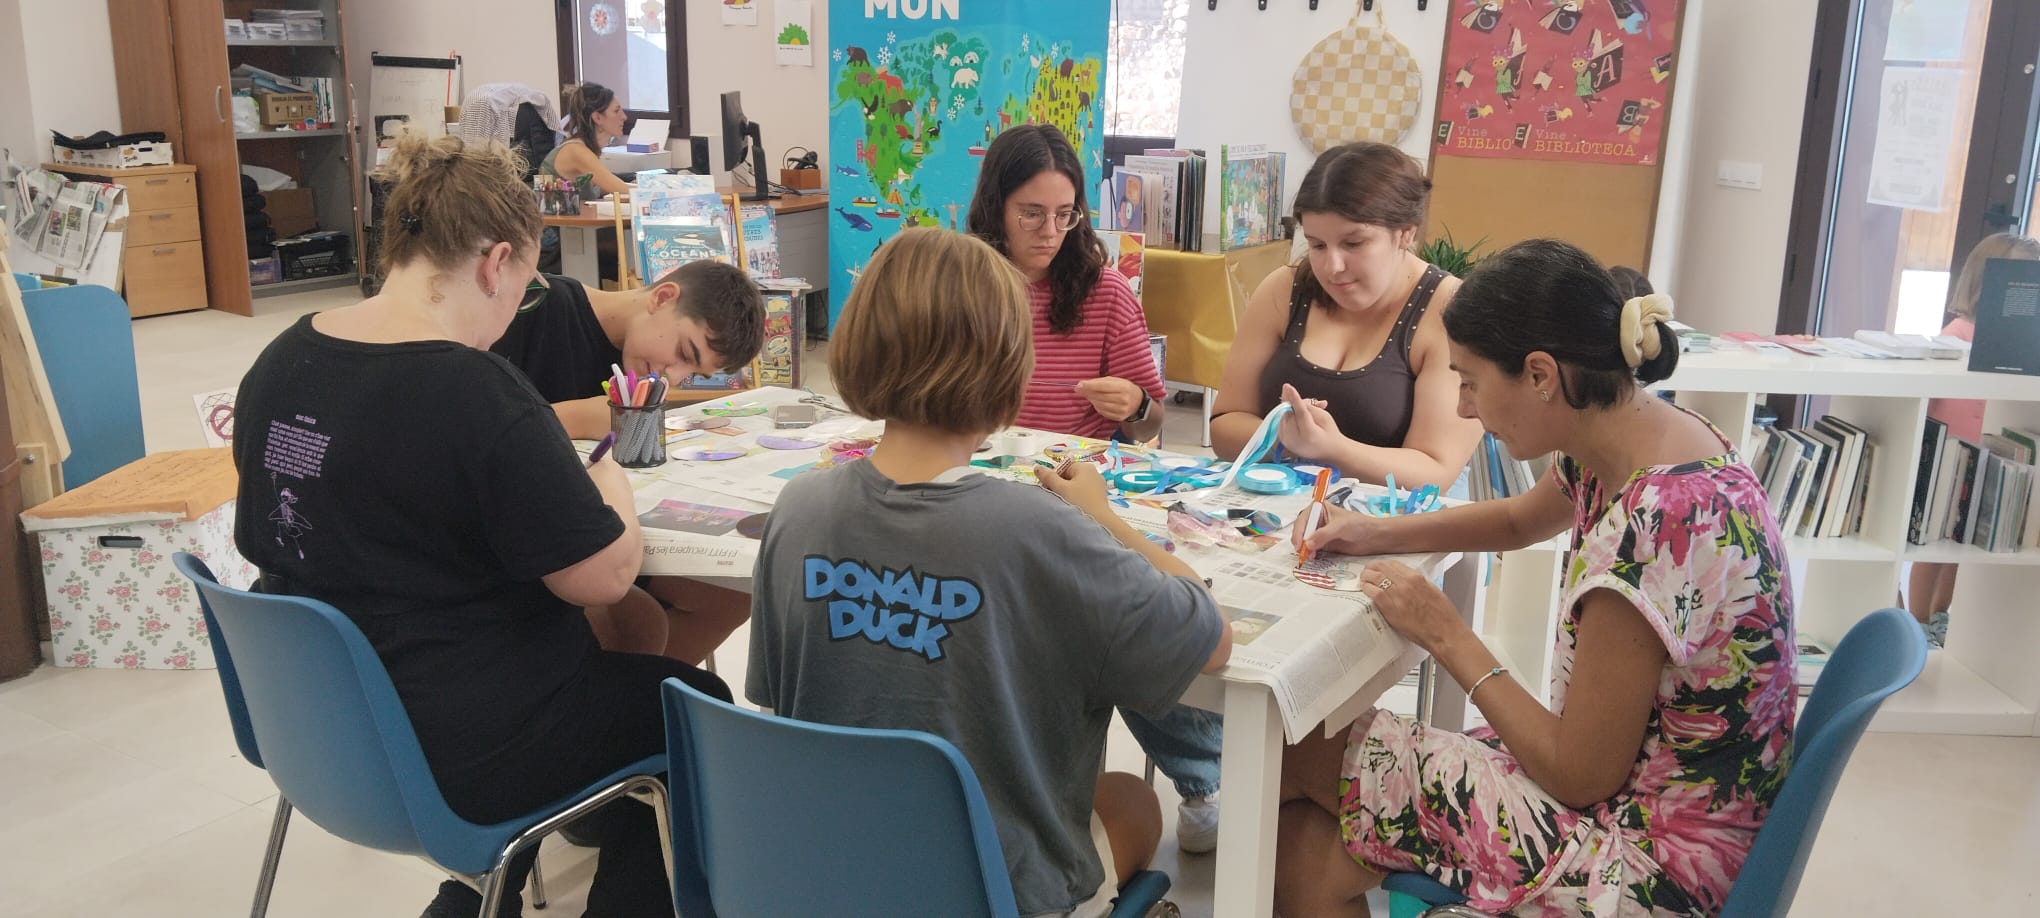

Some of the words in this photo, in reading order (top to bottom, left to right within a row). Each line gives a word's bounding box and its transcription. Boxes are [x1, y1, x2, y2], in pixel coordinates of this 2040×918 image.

[1457, 126, 1488, 137] Vine
[1535, 128, 1567, 140] Vine
[1456, 136, 1514, 151] BIBLIO
[1534, 139, 1637, 156] BIBLIOTECA
[804, 556, 983, 621] DONALD
[828, 600, 950, 661] DUCK
